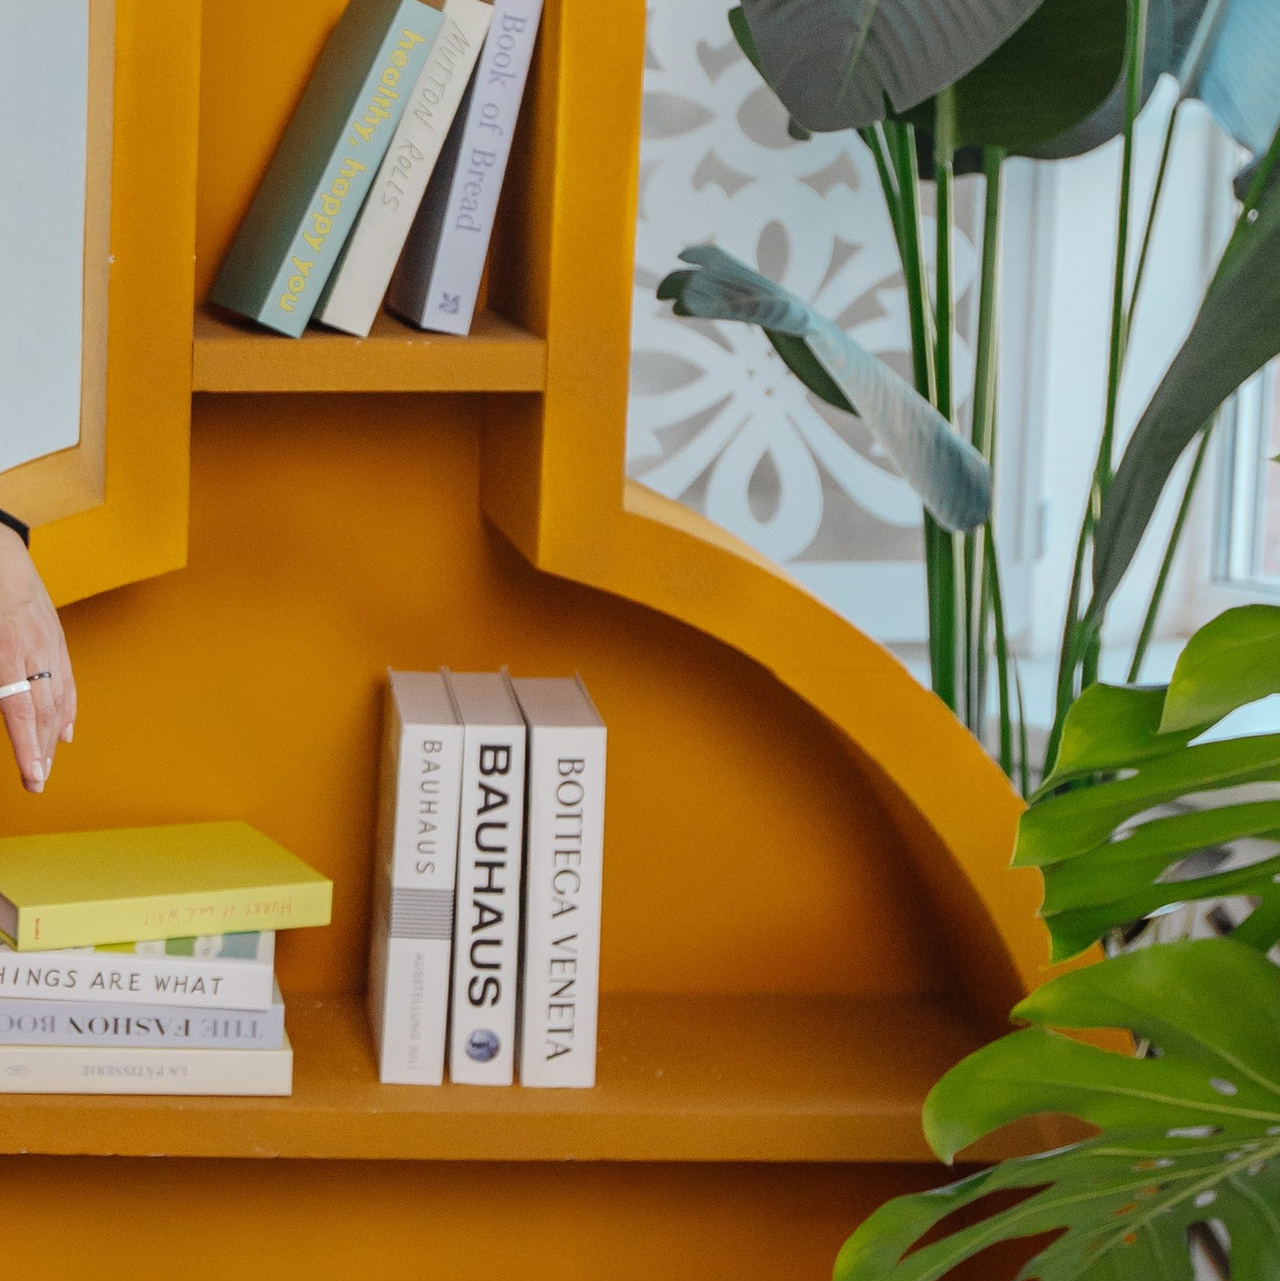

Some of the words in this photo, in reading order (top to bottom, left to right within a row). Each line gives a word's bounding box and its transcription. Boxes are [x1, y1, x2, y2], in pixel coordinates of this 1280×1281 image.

[348, 28, 426, 147] healthy,
[413, 19, 471, 131] MUTTON
[488, 14, 528, 86] Book
[477, 102, 504, 137] of
[302, 157, 367, 253] happy
[382, 136, 425, 211] ROLLS
[455, 147, 497, 234] Bread
[279, 255, 315, 313] you
[415, 739, 443, 875] BAUHAUS
[551, 757, 586, 920] BOTTEGA
[467, 743, 513, 1009] BAUHAUS
[89, 972, 142, 993] ARE
[154, 976, 224, 995] WHAT
[201, 1019, 264, 1039] THE
[546, 933, 579, 1062] VENETA
